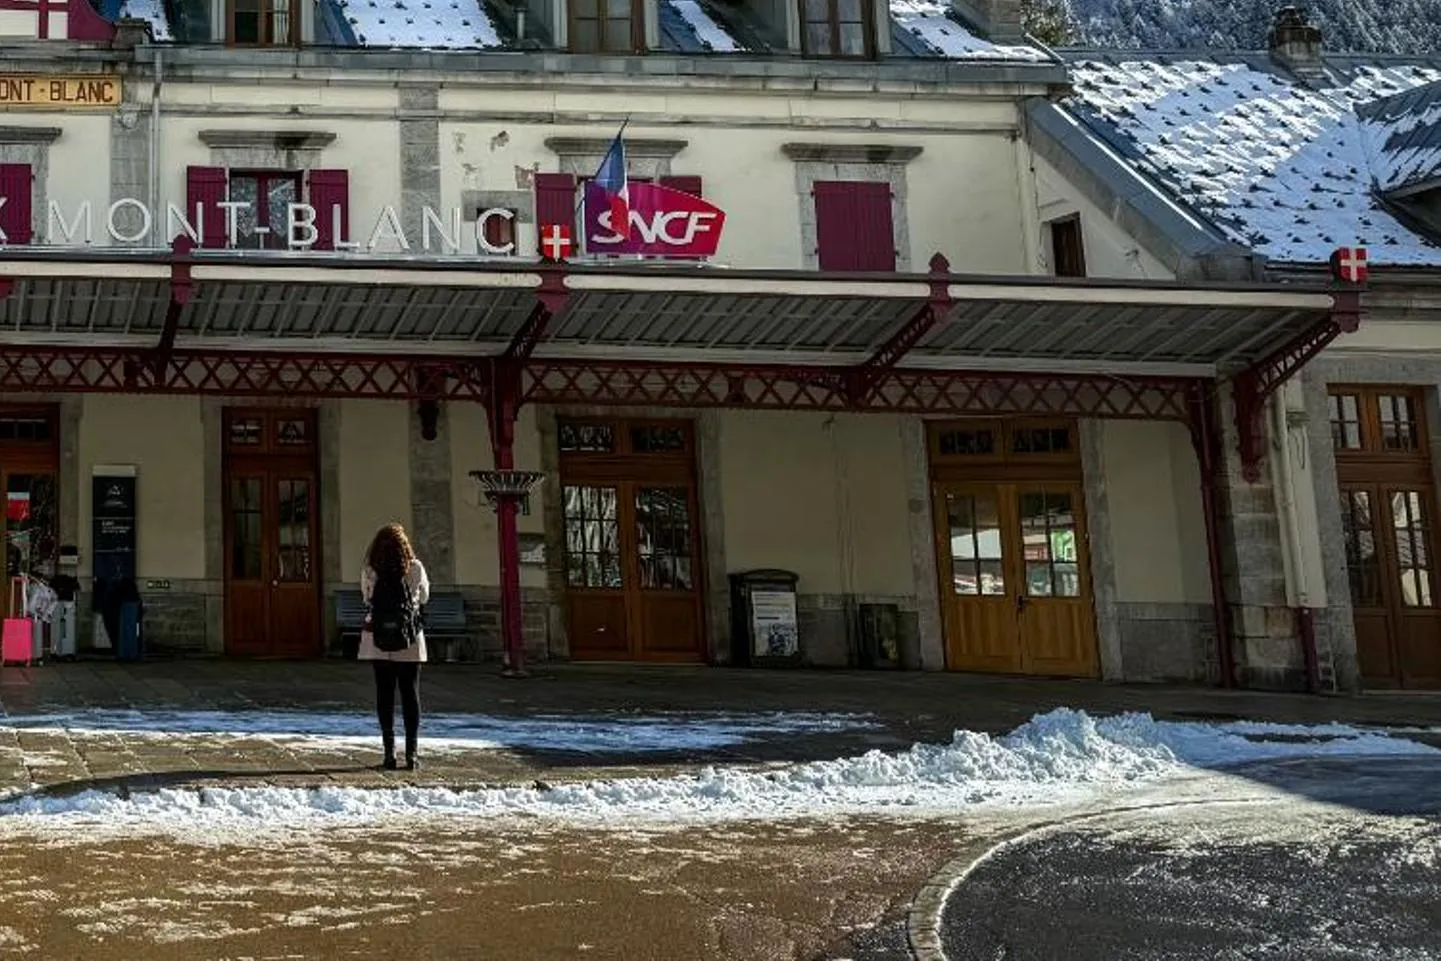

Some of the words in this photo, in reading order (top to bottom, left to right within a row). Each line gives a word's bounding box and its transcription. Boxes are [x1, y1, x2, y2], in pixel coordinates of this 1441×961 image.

[49, 80, 113, 103] BLANC
[46, 197, 516, 255] MONT-BLANC
[591, 209, 718, 246] SNCF
